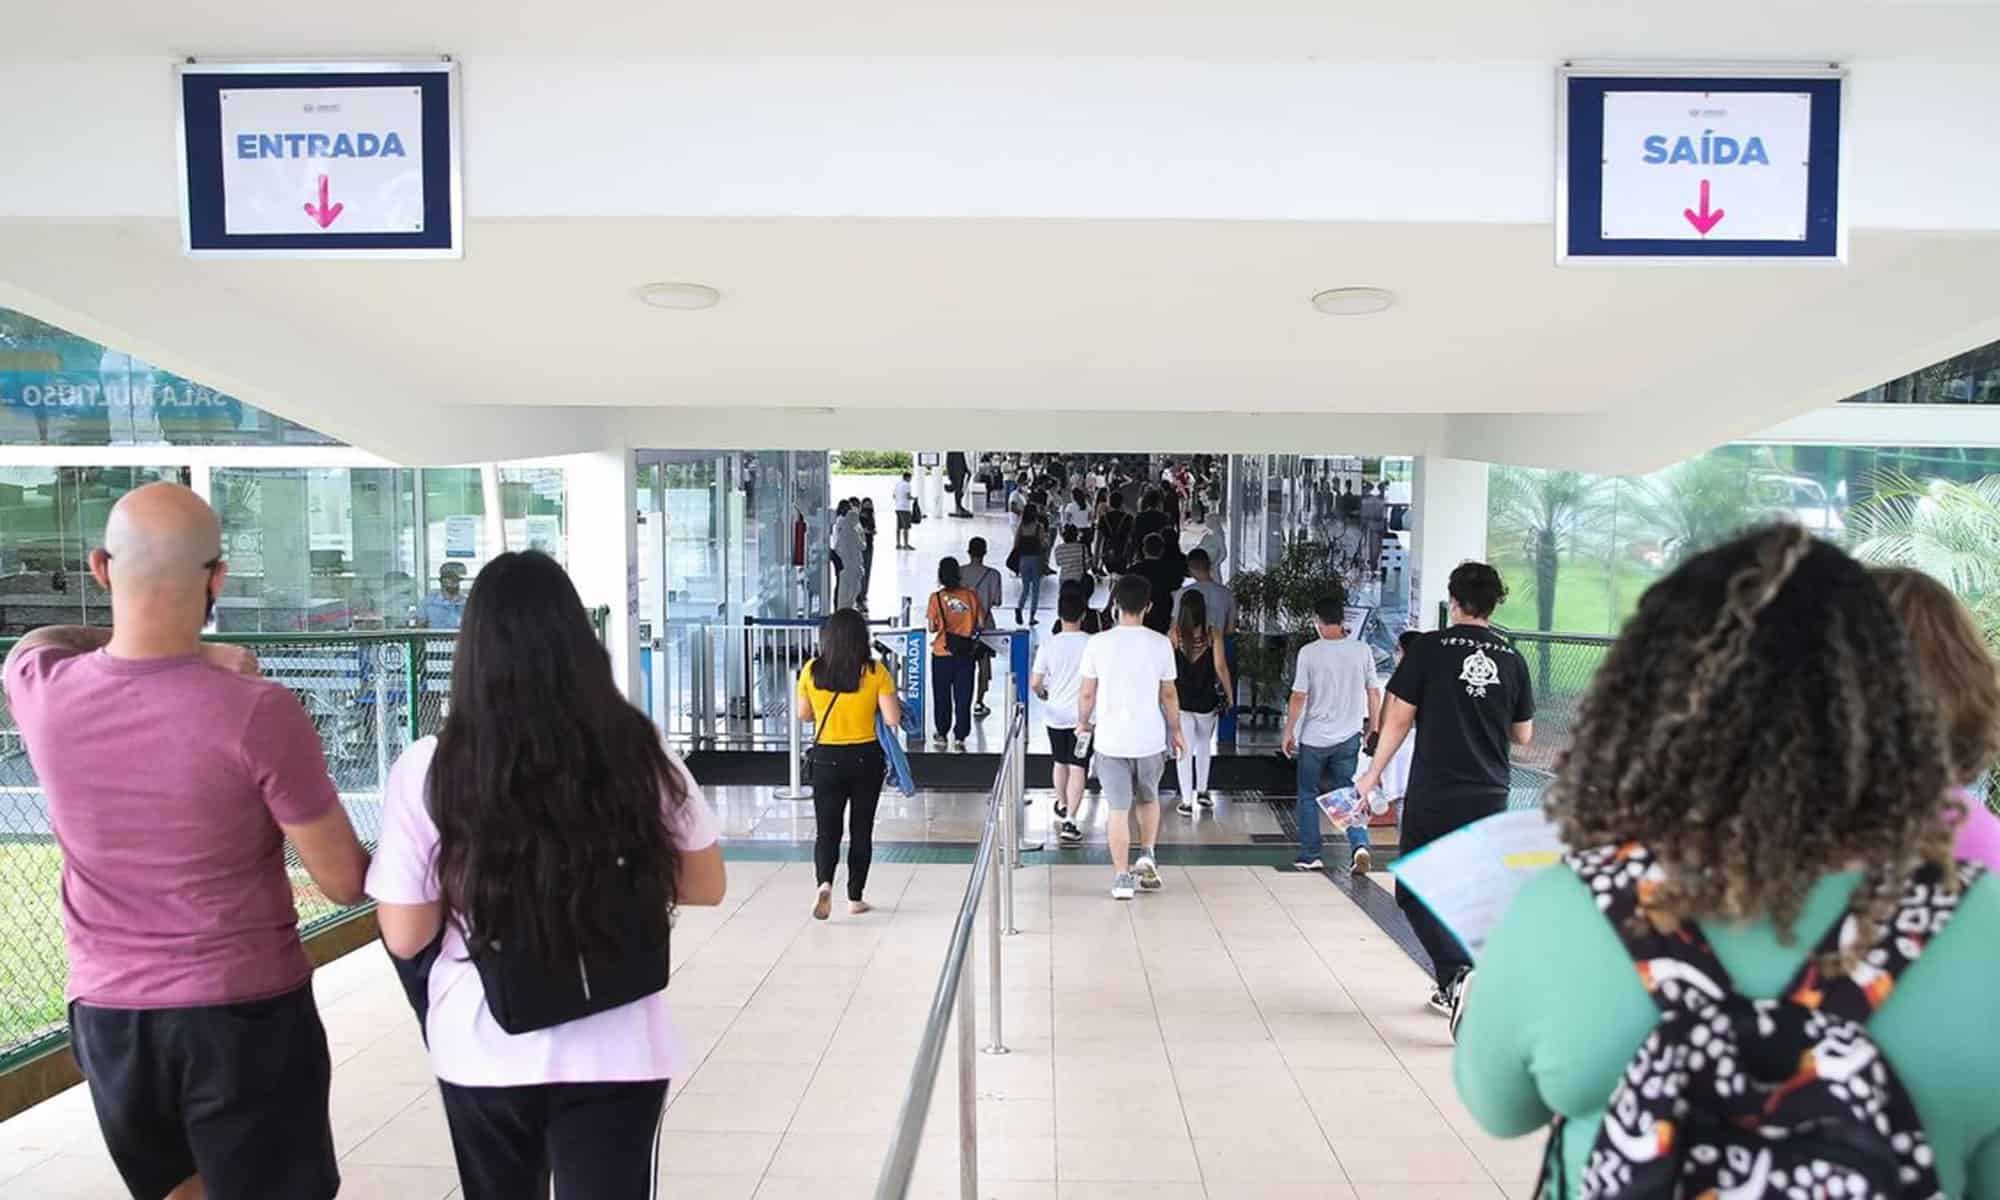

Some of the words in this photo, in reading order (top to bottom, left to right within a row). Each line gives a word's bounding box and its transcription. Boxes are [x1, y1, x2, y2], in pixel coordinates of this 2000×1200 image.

[236, 132, 406, 160] ENTRADA
[1641, 129, 1770, 166] SAÍDA
[907, 637, 921, 700] ENTRADA
